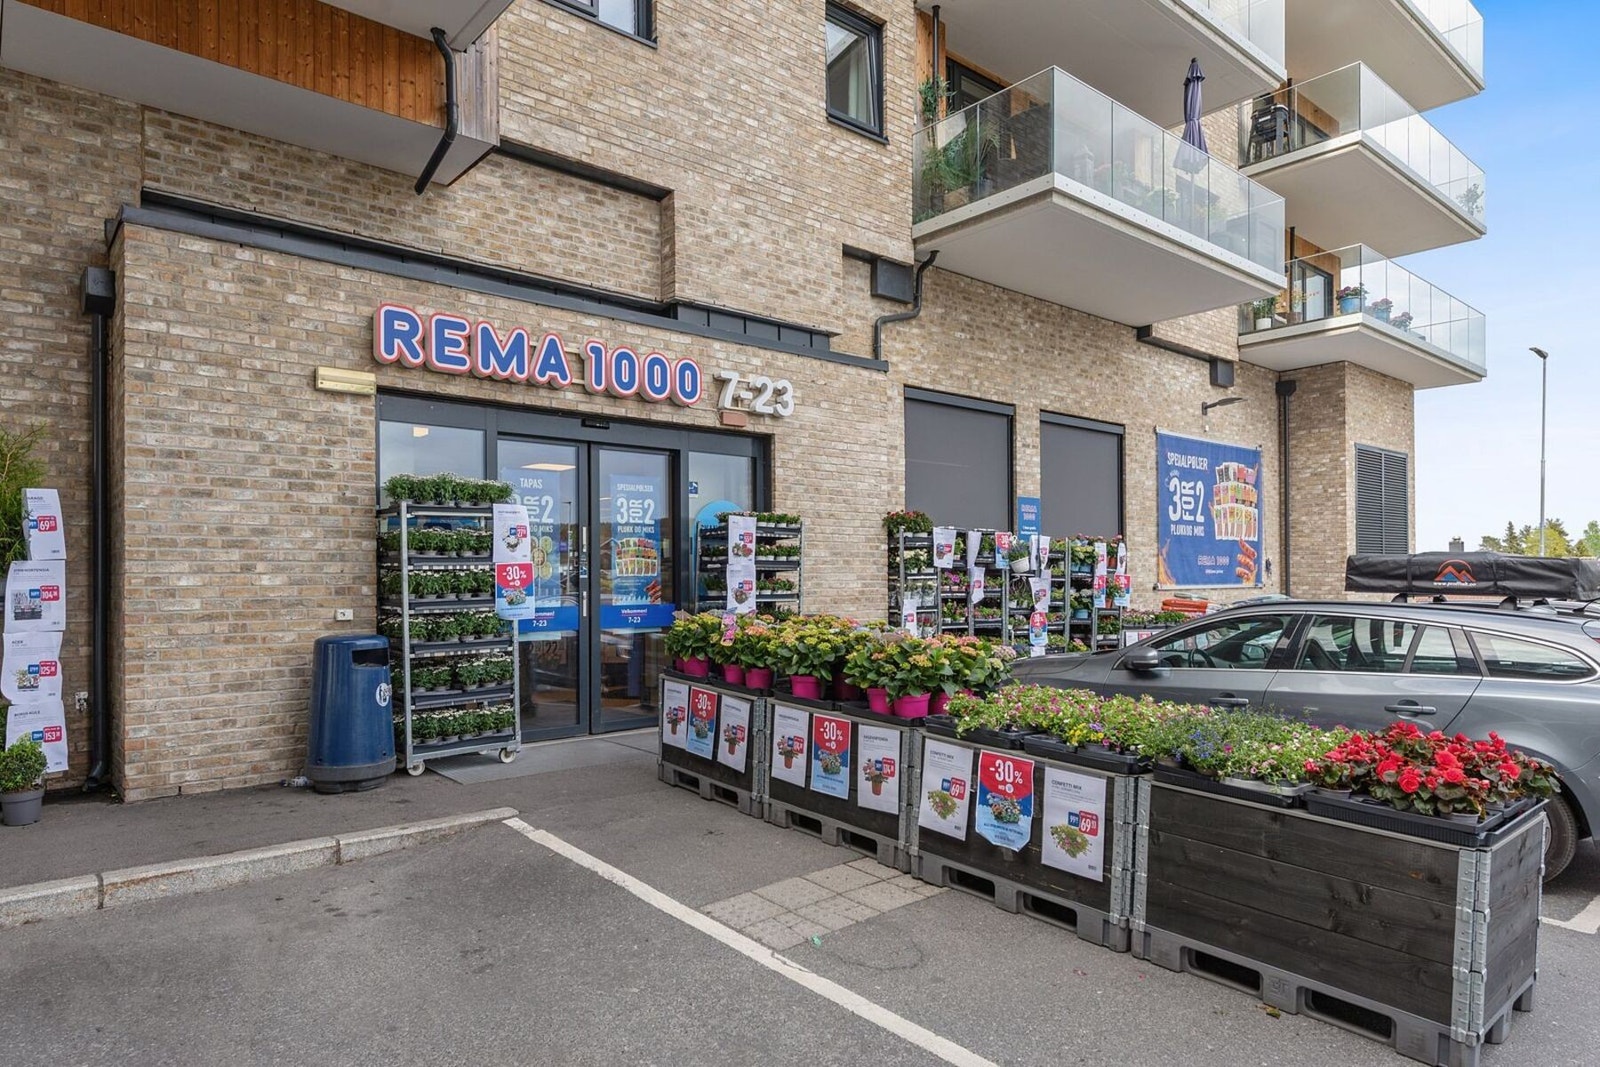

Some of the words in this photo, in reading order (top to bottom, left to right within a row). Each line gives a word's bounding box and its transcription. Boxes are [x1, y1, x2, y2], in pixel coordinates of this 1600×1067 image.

[375, 303, 572, 389] REMA
[581, 339, 703, 407] 1000
[713, 370, 795, 417] 7-23
[520, 477, 544, 490] TAPAS
[1168, 477, 1182, 521] 3
[1181, 481, 1195, 521] FOR
[1196, 480, 1205, 523] 2
[541, 494, 555, 524] 2
[617, 497, 629, 525] 3
[629, 499, 643, 524] FOR
[644, 498, 655, 526] 2
[39, 519, 50, 531] 69
[502, 566, 527, 581] -30%
[532, 619, 548, 627] 7-23
[628, 616, 641, 624] 7-23
[819, 721, 843, 741] -30%
[989, 759, 1023, 785] -30%
[951, 783, 960, 797] 69
[1080, 818, 1091, 833] 69
